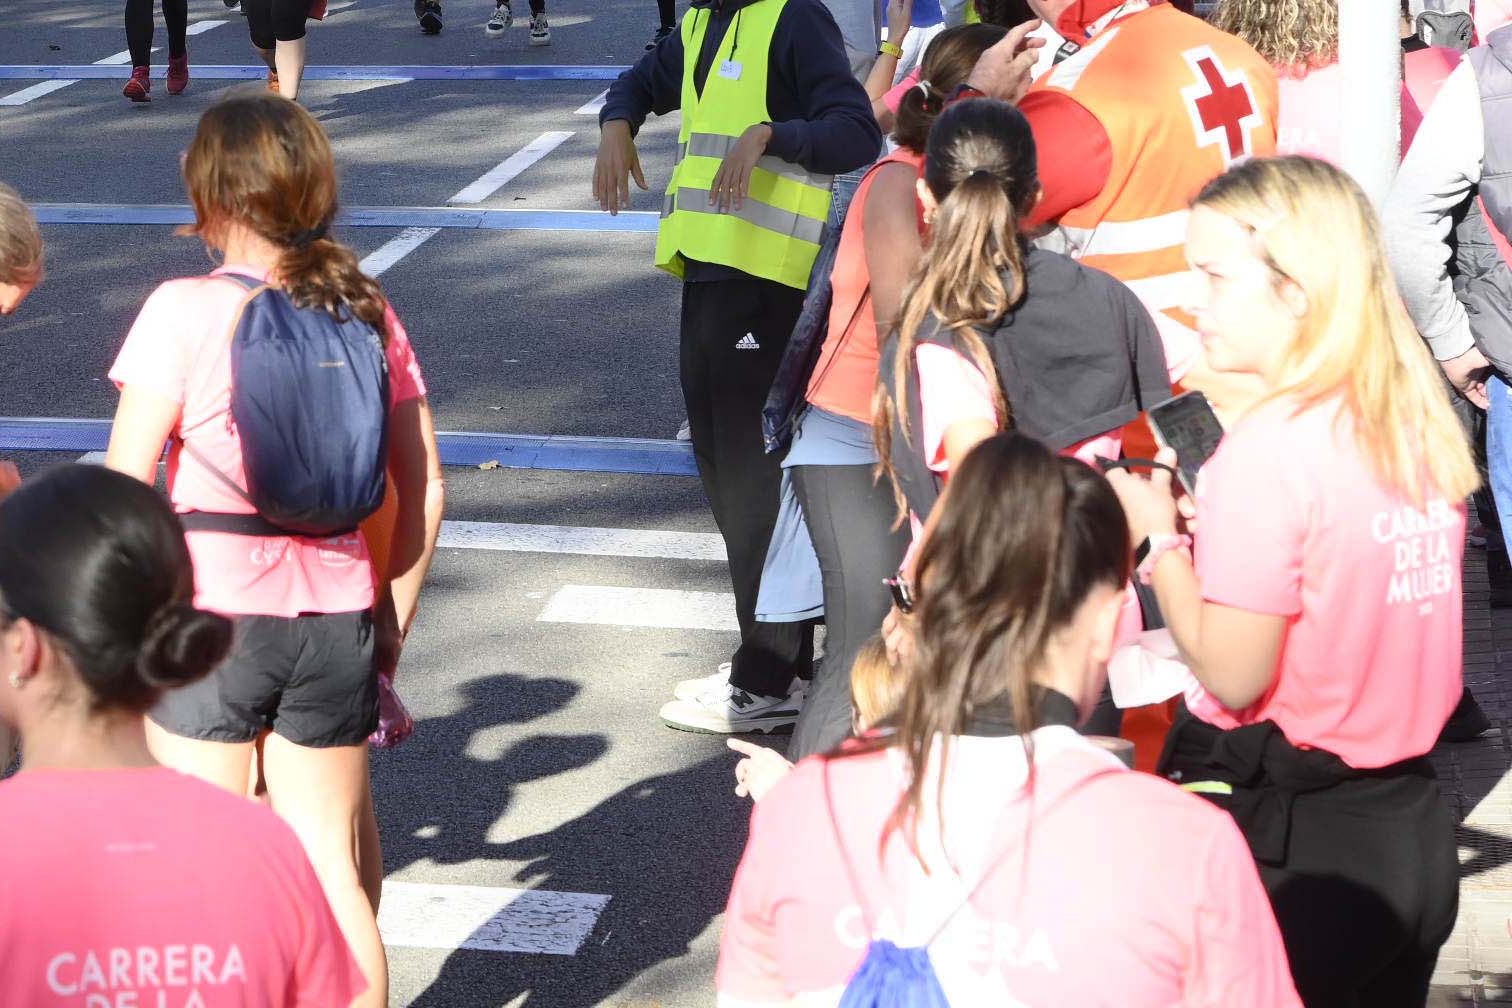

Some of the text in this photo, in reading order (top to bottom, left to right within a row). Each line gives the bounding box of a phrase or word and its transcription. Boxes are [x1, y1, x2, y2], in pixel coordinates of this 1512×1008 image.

[1395, 533, 1450, 572] DE LA
[46, 944, 248, 997] CARRERA
